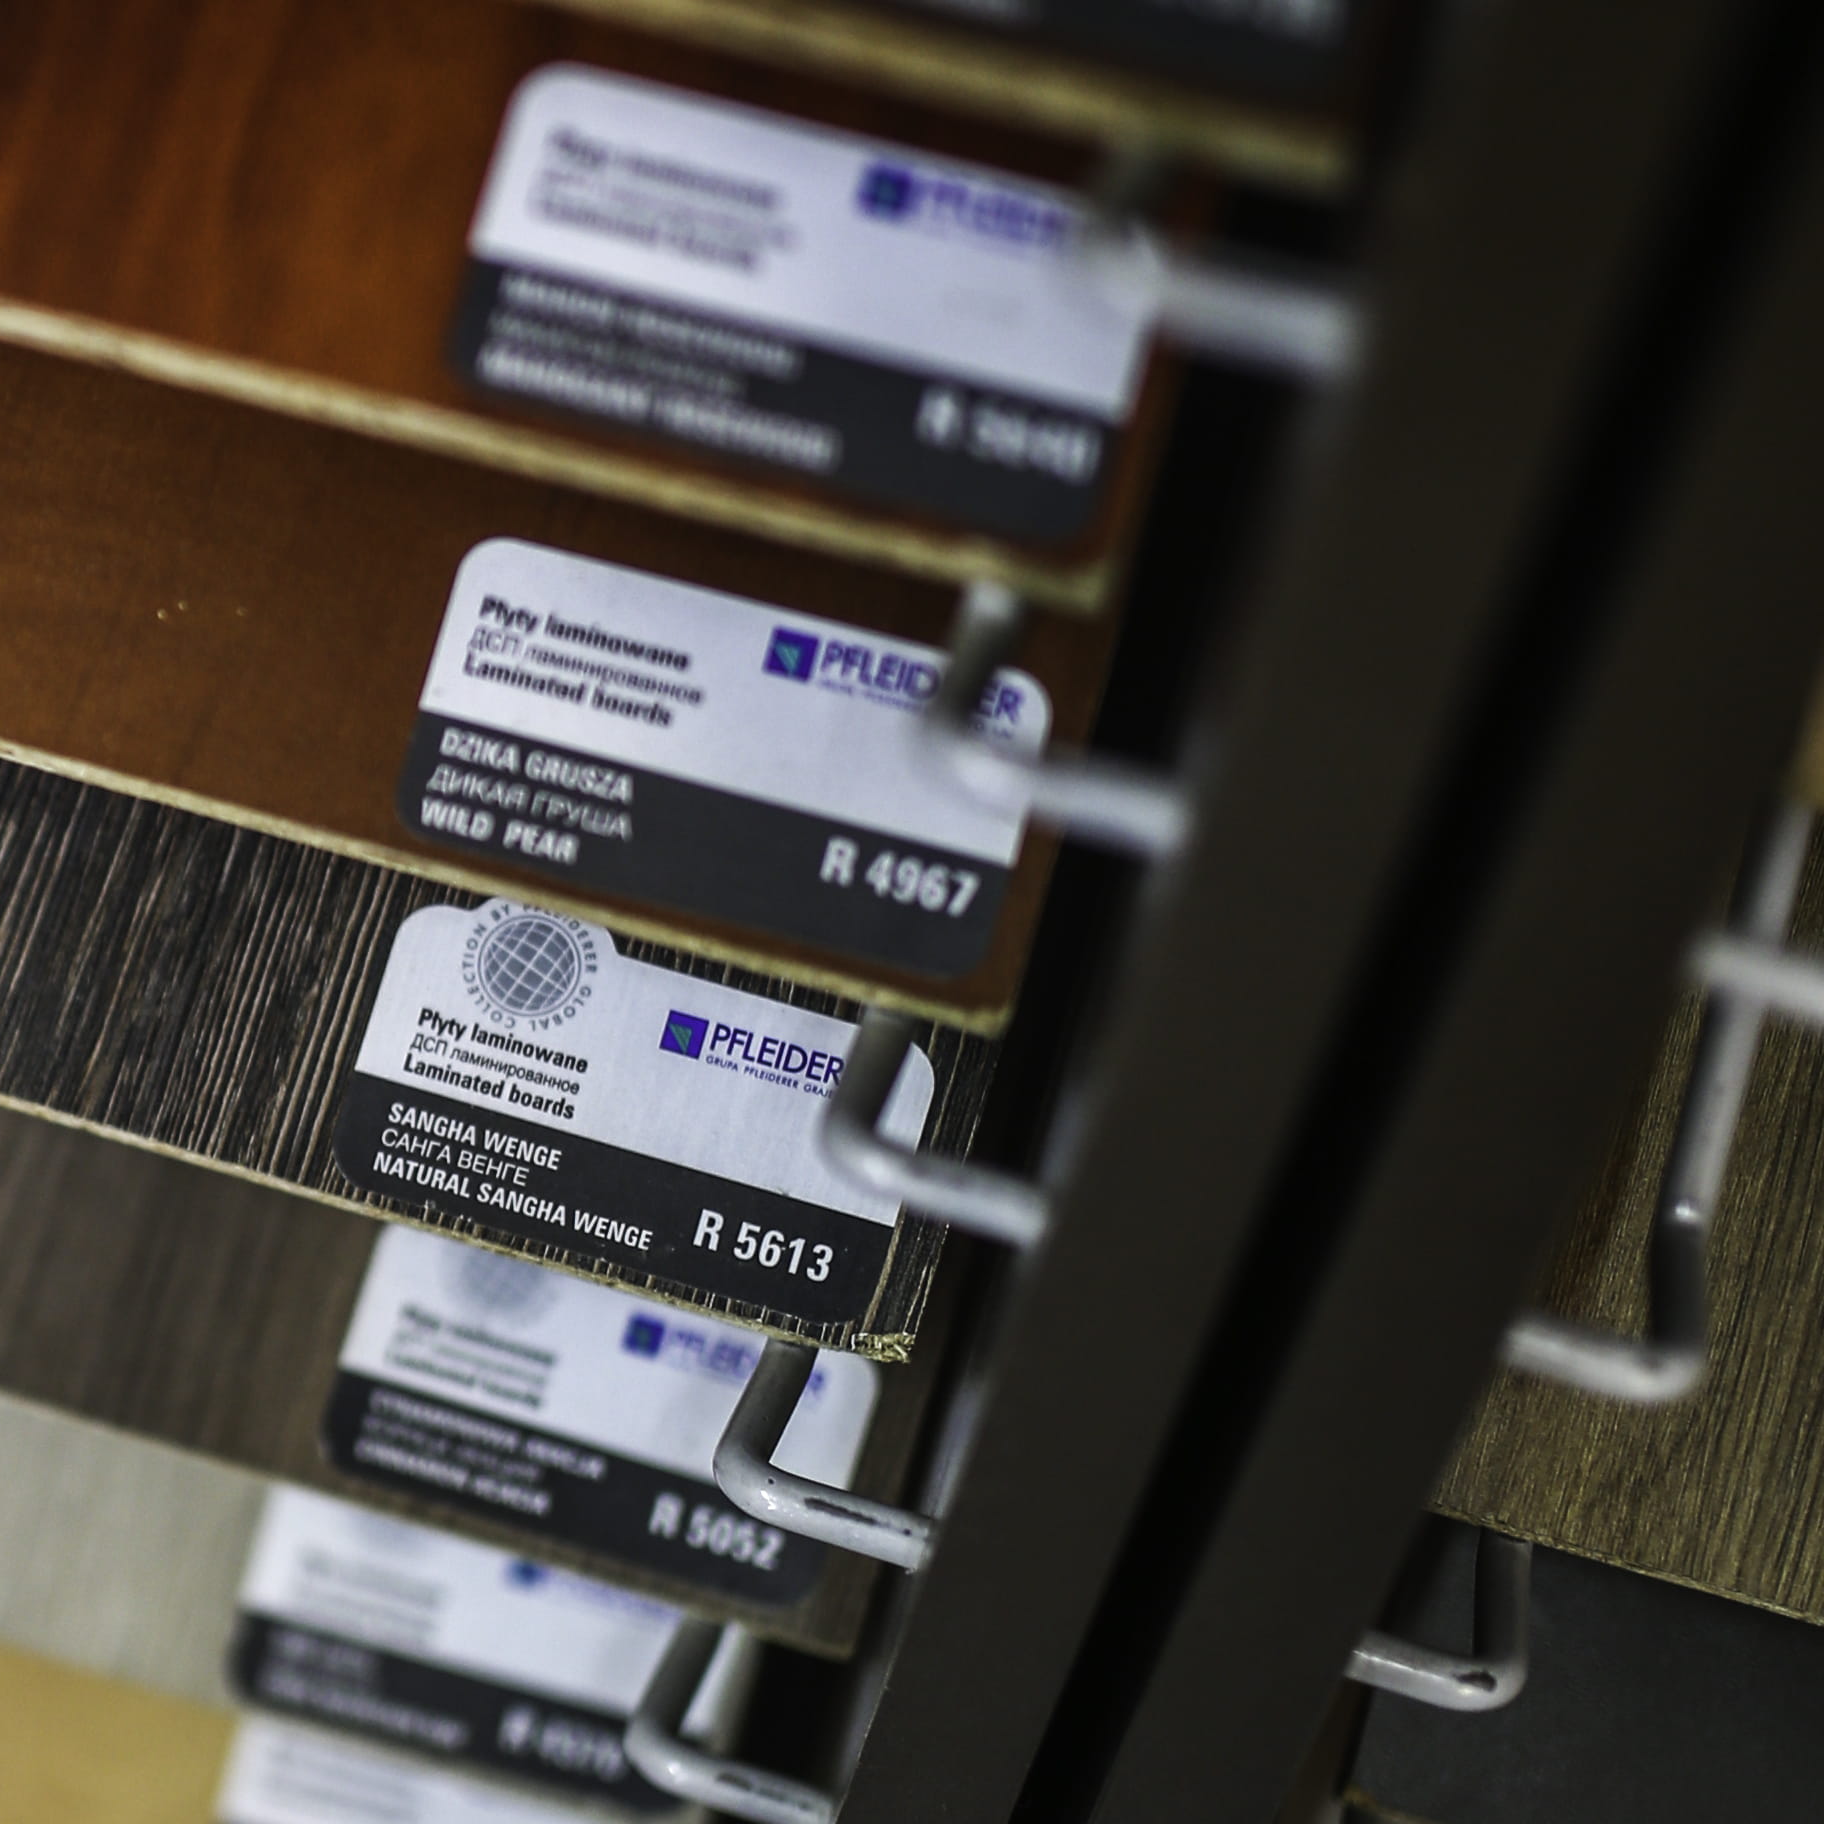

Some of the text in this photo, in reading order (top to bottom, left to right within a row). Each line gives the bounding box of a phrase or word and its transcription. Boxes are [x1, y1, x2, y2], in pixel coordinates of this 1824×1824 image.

[545, 613, 690, 671] laminowane
[463, 651, 672, 727] Laminated boards
[820, 639, 1024, 724] PFLEIDER
[440, 727, 633, 804] DZIKA GRUSZA
[421, 796, 580, 865] WILD PEAR
[426, 763, 632, 841] ДИКАЯ ГРУША
[819, 836, 981, 917] R 4967
[491, 904, 510, 922] BY
[462, 923, 516, 1029] COLLECTION
[530, 985, 592, 1031] GLOBAL
[409, 1033, 580, 1095] ДСП ламинированное
[418, 1008, 589, 1074] Płyty laminowane
[709, 1023, 845, 1086] PFLEIDER
[403, 1053, 576, 1119] Laminated boards
[706, 1054, 833, 1099] GRUPA PFLEIDERER GRAJ
[381, 1128, 530, 1186] САНГА ВЕНГЕ
[388, 1102, 562, 1171] SANGHA WENGE
[373, 1151, 654, 1251] NATURAL SANGHA WENGE
[693, 1208, 833, 1282] R 5613
[648, 1492, 785, 1571] R 5052
